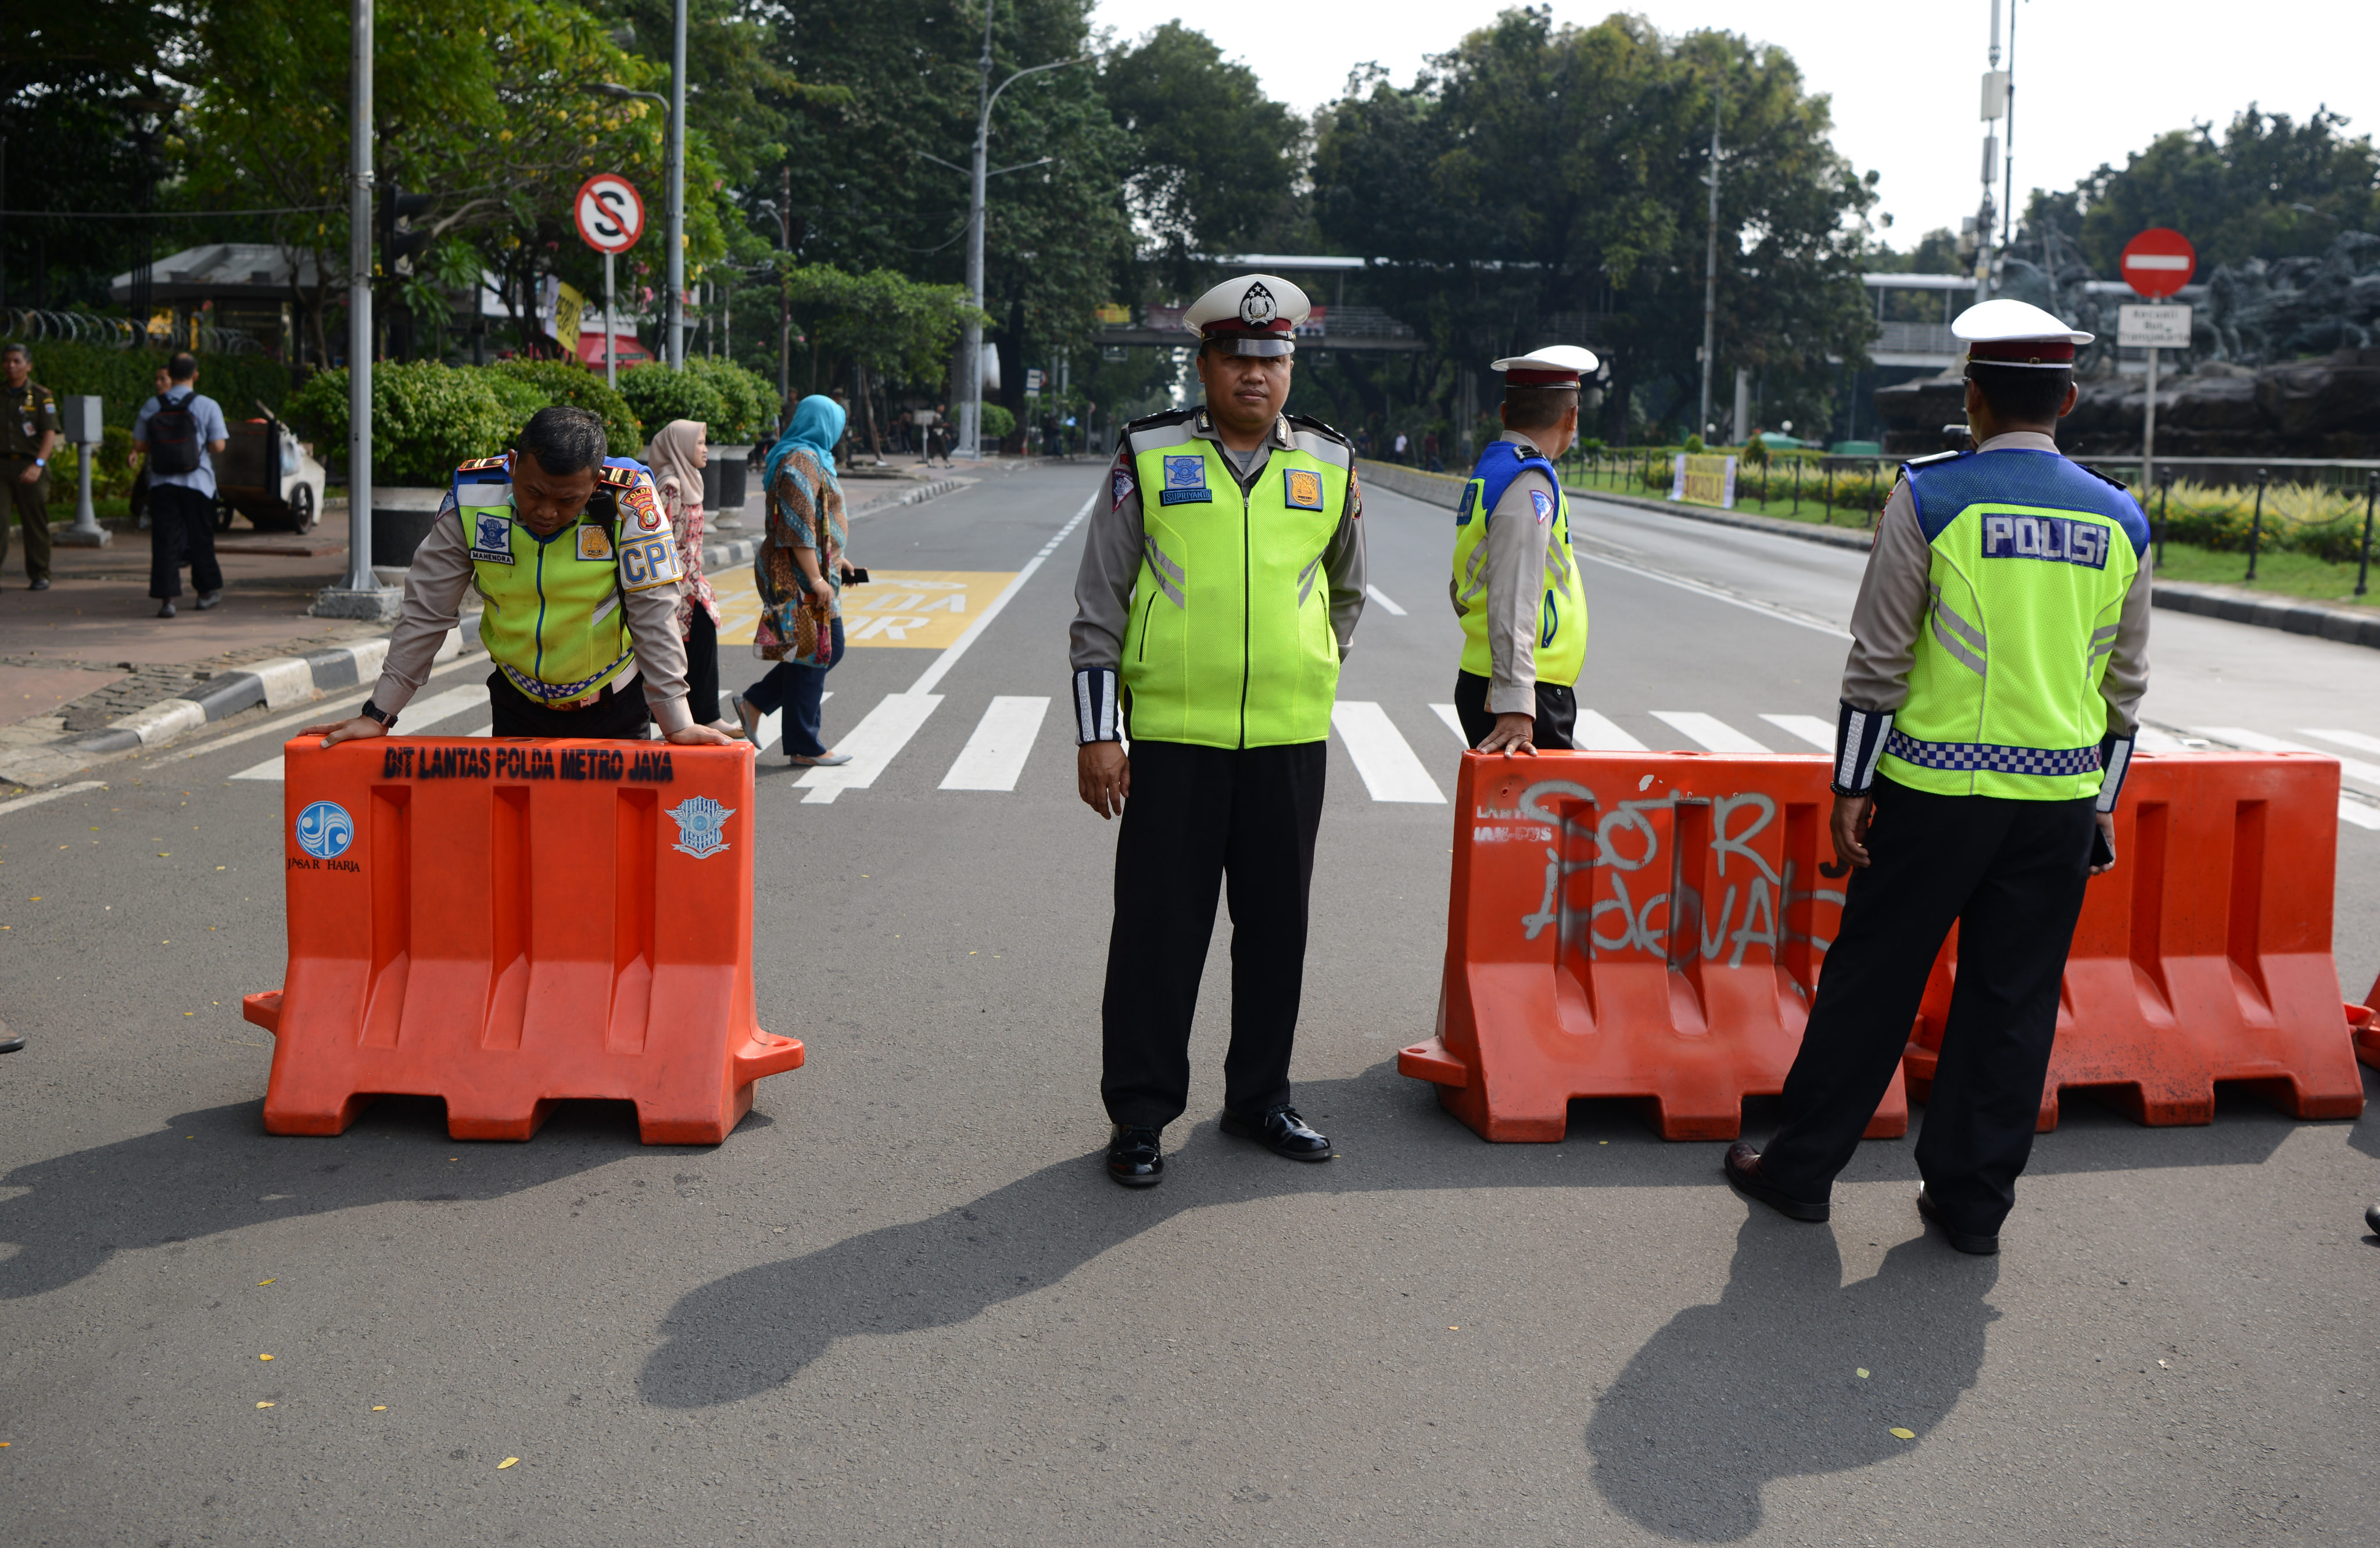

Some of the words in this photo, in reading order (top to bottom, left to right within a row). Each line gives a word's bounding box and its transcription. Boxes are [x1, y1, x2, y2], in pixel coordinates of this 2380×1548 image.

[626, 488, 651, 503] POLDA
[1167, 490, 1210, 501] SUPRIYANTO
[1986, 517, 2107, 565] POLISI
[472, 551, 511, 563] MAHENDRA
[384, 746, 415, 779] DIT
[418, 746, 490, 779] LANTAS
[496, 747, 555, 780] POLDA
[560, 748, 624, 781] METRO
[628, 750, 673, 782] JAYA
[287, 857, 311, 870] JASA
